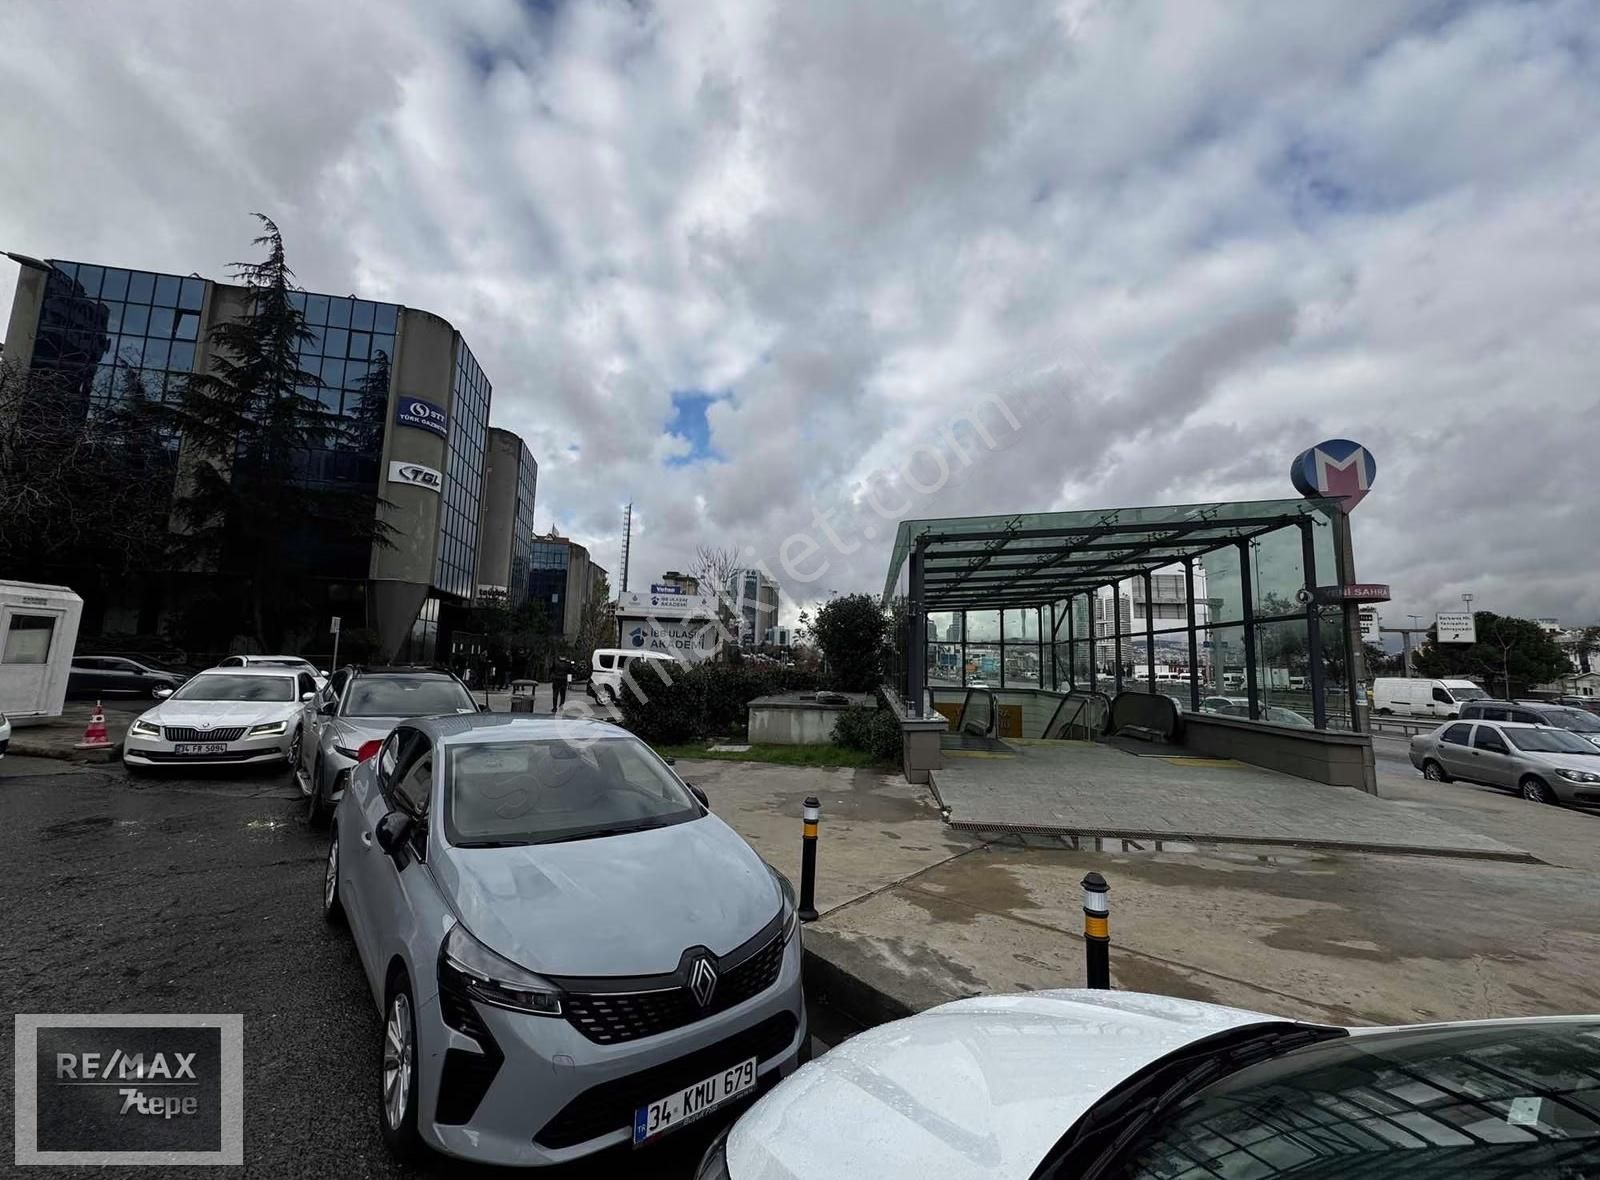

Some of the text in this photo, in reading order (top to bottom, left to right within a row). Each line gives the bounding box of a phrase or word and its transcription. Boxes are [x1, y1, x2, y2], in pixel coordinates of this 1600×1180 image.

[400, 414, 420, 424] TÜRK
[411, 469, 440, 488] TGL
[1314, 447, 1368, 492] M
[1353, 587, 1388, 597] SAHRA
[649, 1100, 671, 1131] 34
[683, 1078, 717, 1116] KMU
[724, 1060, 754, 1095] 679
